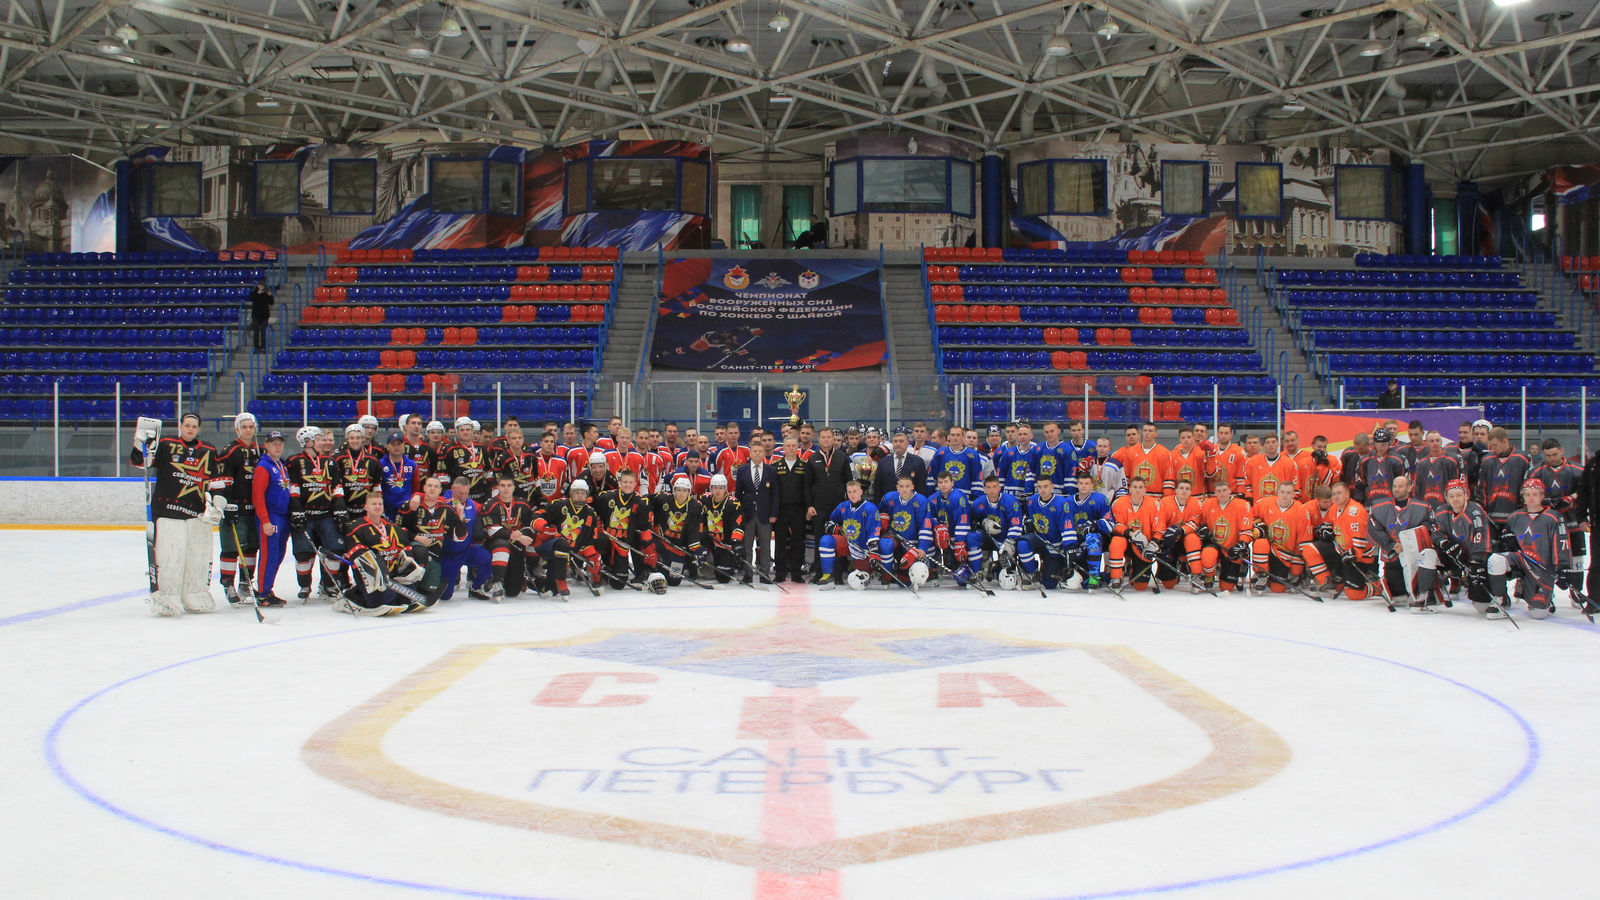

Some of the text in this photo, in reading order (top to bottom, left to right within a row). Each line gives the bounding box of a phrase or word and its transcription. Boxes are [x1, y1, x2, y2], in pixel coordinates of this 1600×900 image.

[689, 302, 853, 313] РОССИЙСКОЙ ФЕДЕРАЦИИ
[709, 298, 805, 306] ВООРУЖЕННЫХ
[719, 311, 773, 319] ХОККЕЮ
[787, 310, 842, 319] ШАЙБОЙ
[169, 443, 184, 454] 72
[403, 465, 413, 473] 83
[618, 745, 998, 768] САНКТ-
[525, 768, 1084, 795] ПЕТЕРБУРГ
